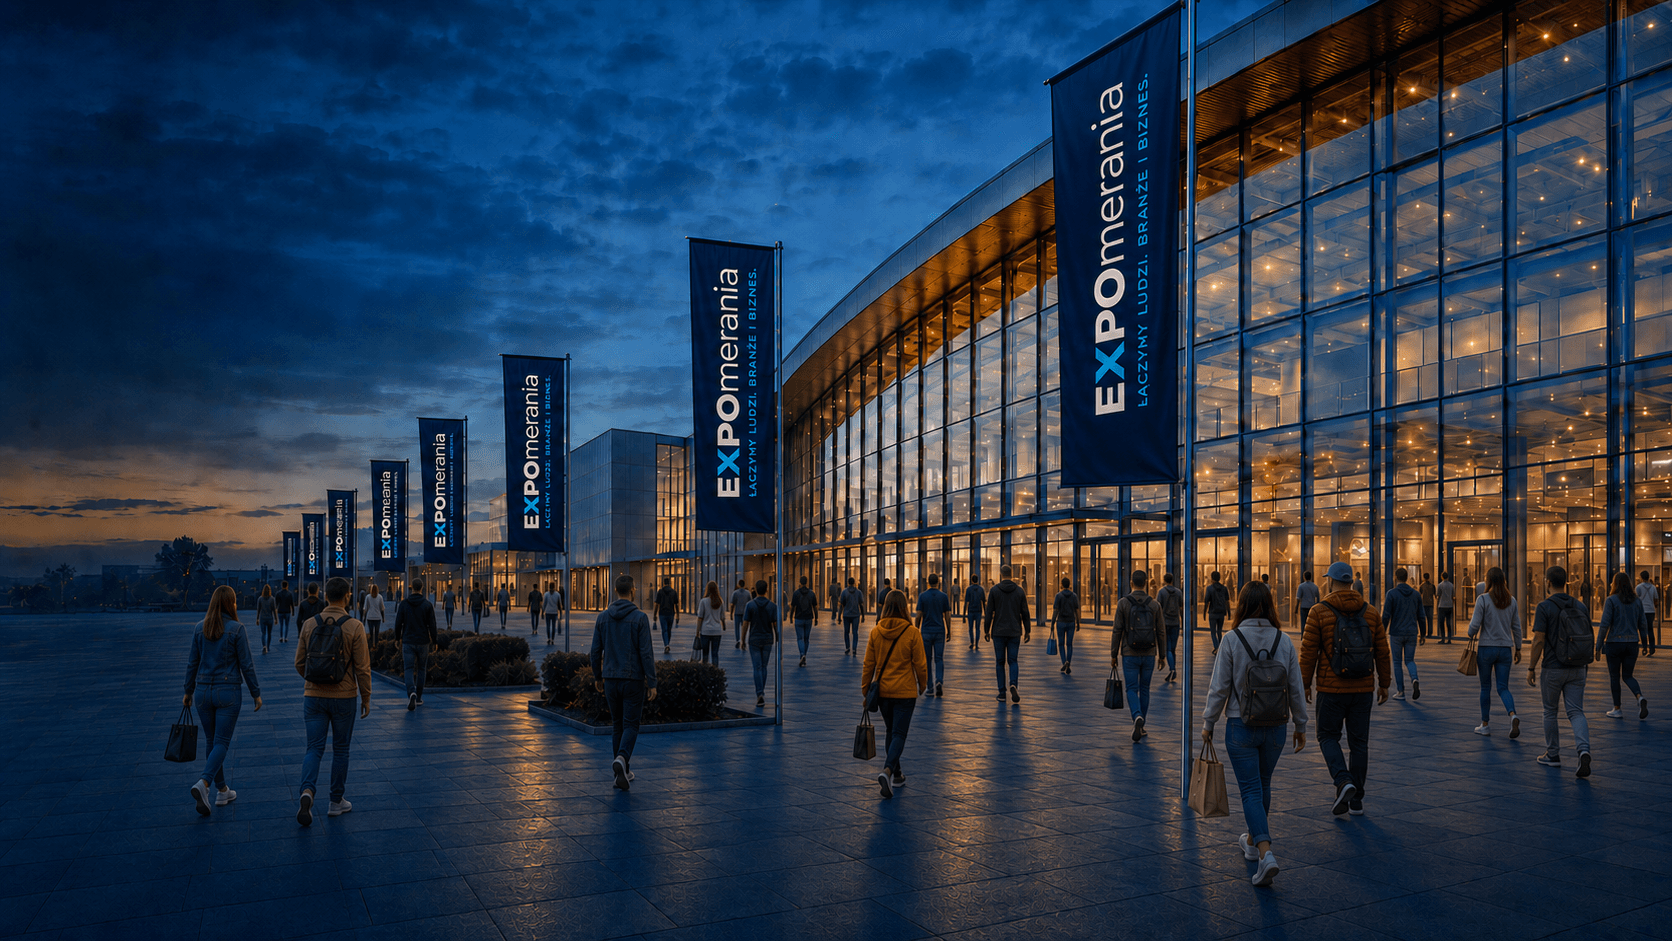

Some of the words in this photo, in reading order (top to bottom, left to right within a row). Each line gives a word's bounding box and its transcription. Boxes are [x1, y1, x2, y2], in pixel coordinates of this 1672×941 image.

[1137, 72, 1149, 151] BIZNES.
[1137, 156, 1149, 164] I
[1135, 168, 1149, 247] BRANŻE
[1090, 81, 1126, 416] EXPOmerania
[1137, 254, 1149, 316] LUDZI.
[748, 268, 757, 321] BIZNES.
[713, 268, 741, 498] EXPOmerania
[746, 334, 757, 387] BRANŻE
[1137, 324, 1151, 408] ŁĄCZYMY
[521, 374, 540, 529] EXPOmerania
[748, 392, 757, 434] LUDZI.
[432, 433, 447, 548] EXPOmerania
